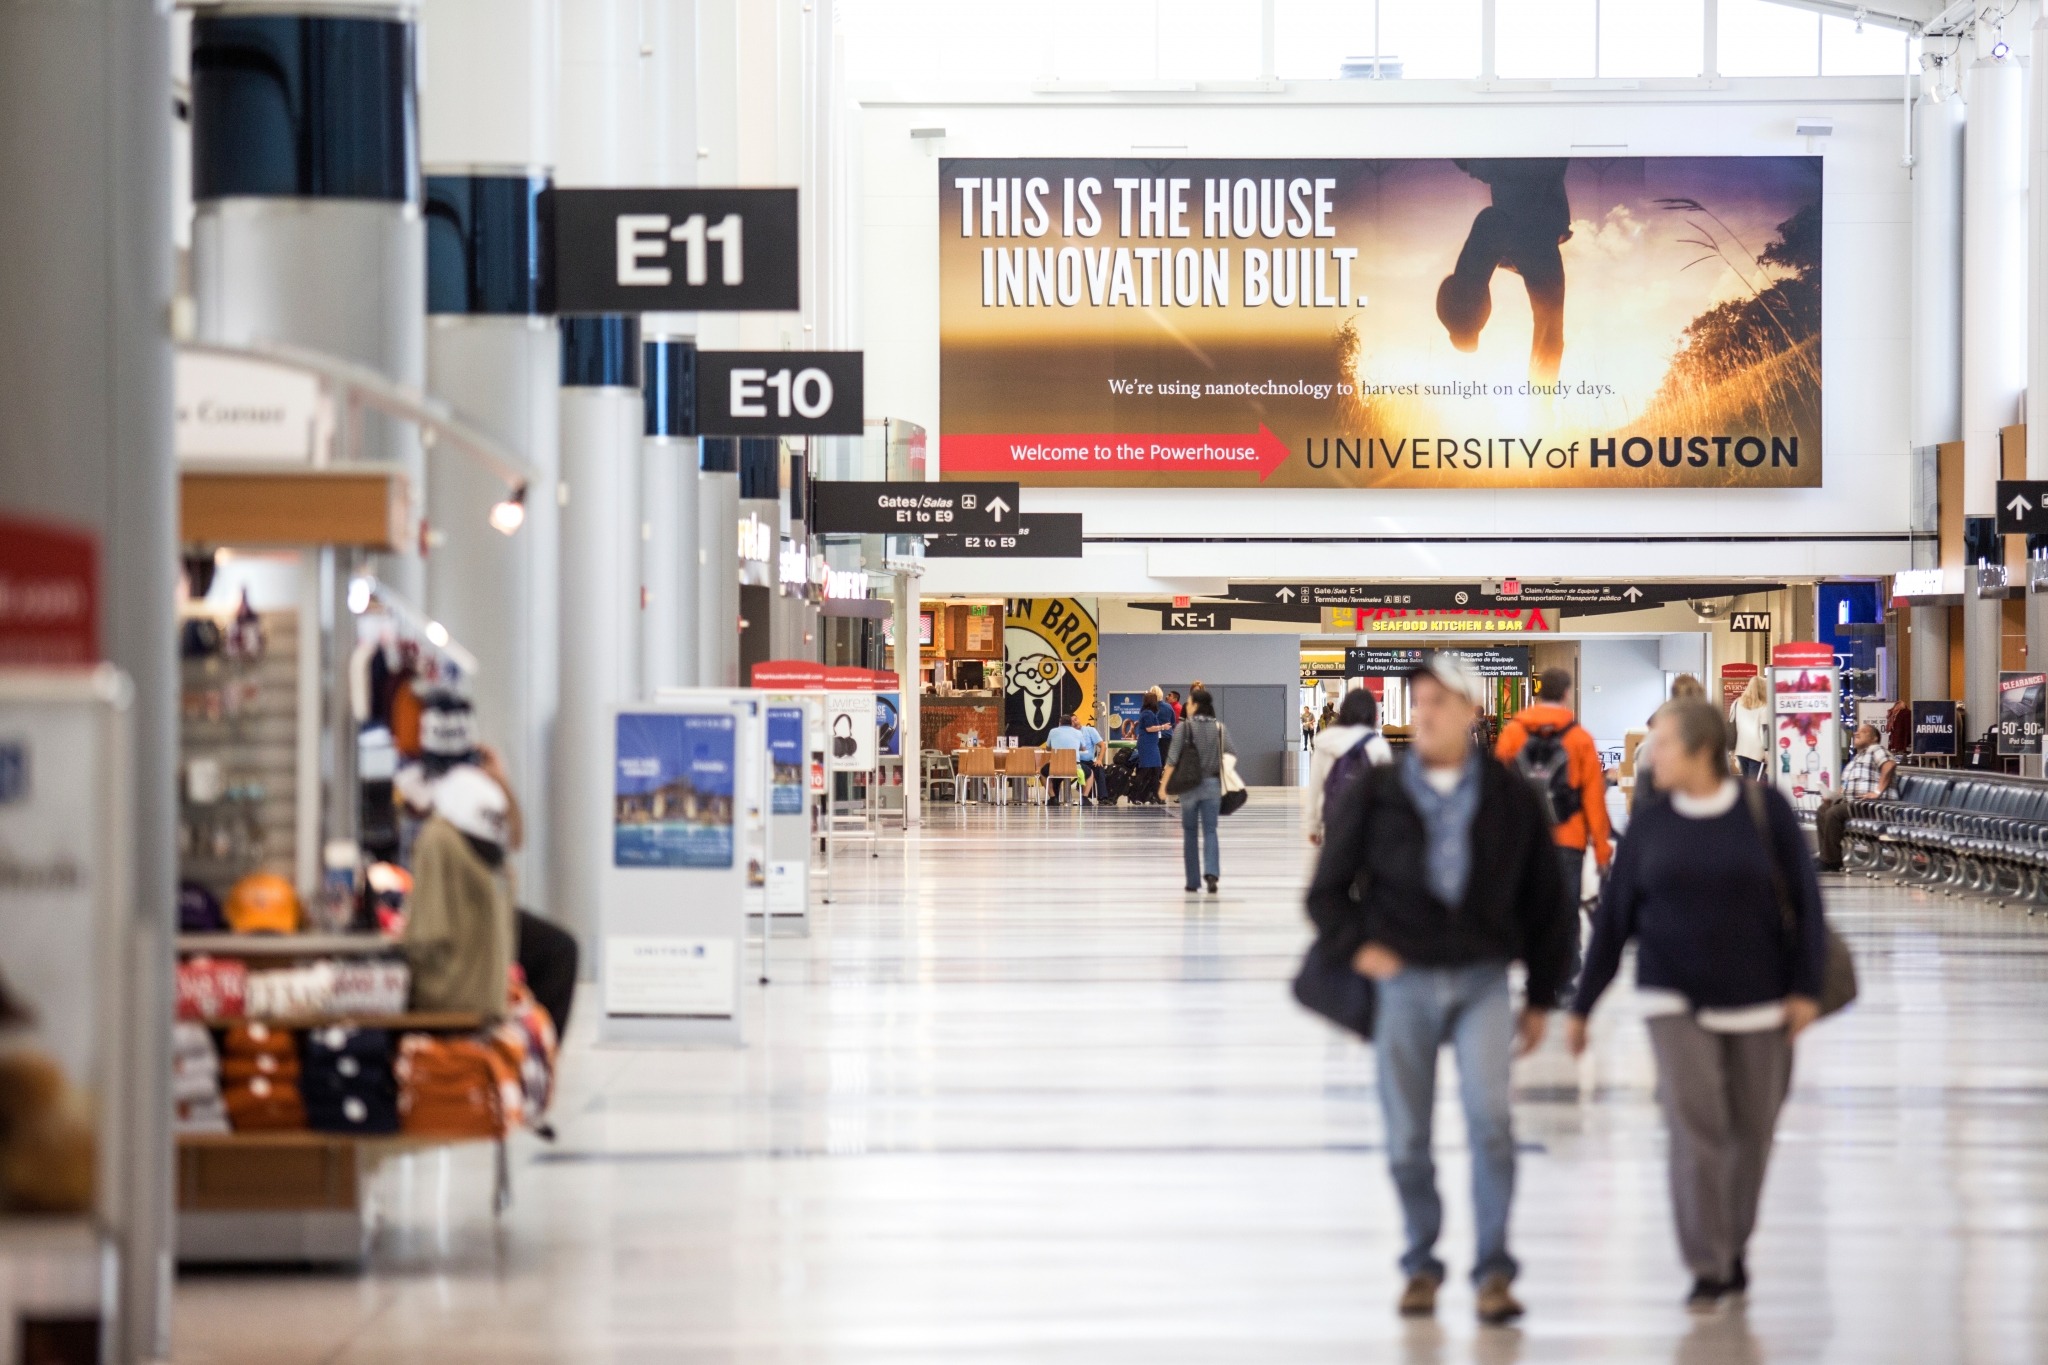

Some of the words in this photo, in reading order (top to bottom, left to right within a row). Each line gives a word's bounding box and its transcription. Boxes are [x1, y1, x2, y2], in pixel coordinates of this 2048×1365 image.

[955, 177, 1050, 238] THIS
[1062, 178, 1102, 238] IS
[1113, 178, 1190, 238] THE
[1203, 178, 1336, 238] HOUSE
[615, 213, 744, 287] E11
[981, 247, 1229, 307] INNOVATION
[1243, 248, 1368, 308] BUILT.
[730, 367, 834, 419] E10
[1108, 379, 1154, 395] We’re
[1158, 382, 1200, 398] using
[1205, 379, 1333, 399] nanotechnology
[1336, 382, 1353, 395] to
[1362, 380, 1419, 395] harvest
[1424, 380, 1488, 399] sunlight
[1493, 383, 1514, 395] on
[1518, 381, 1571, 400] cloudy
[1576, 381, 1616, 399] days.
[1010, 444, 1089, 461] Welcome
[1094, 446, 1112, 461] to
[1116, 444, 1145, 461] the
[1150, 444, 1259, 461] Powerhouse.
[1306, 437, 1542, 469] UNIVERSITY
[1546, 441, 1579, 469] of
[1590, 436, 1799, 468] HOUSTON
[878, 495, 953, 509] Gates/Salas
[896, 510, 912, 522] E1
[916, 511, 930, 522] to
[935, 510, 953, 523] E9
[965, 537, 981, 548] E2
[985, 538, 997, 548] to
[1000, 537, 1016, 548] E9
[1504, 582, 1519, 593] EXIT
[1175, 596, 1189, 607] EXIT
[1186, 613, 1214, 628] E-1
[1373, 621, 1428, 631] SEAFOOD
[1431, 621, 1483, 631] KITCHEN
[1485, 621, 1495, 631] &
[1498, 621, 1522, 631] BAR
[1732, 614, 1769, 630] ATM
[2002, 675, 2044, 690] CLEARANCE!
[1780, 700, 1803, 709] SAVE
[1926, 715, 1943, 724] NEW
[1916, 724, 1953, 734] ARRIVALS
